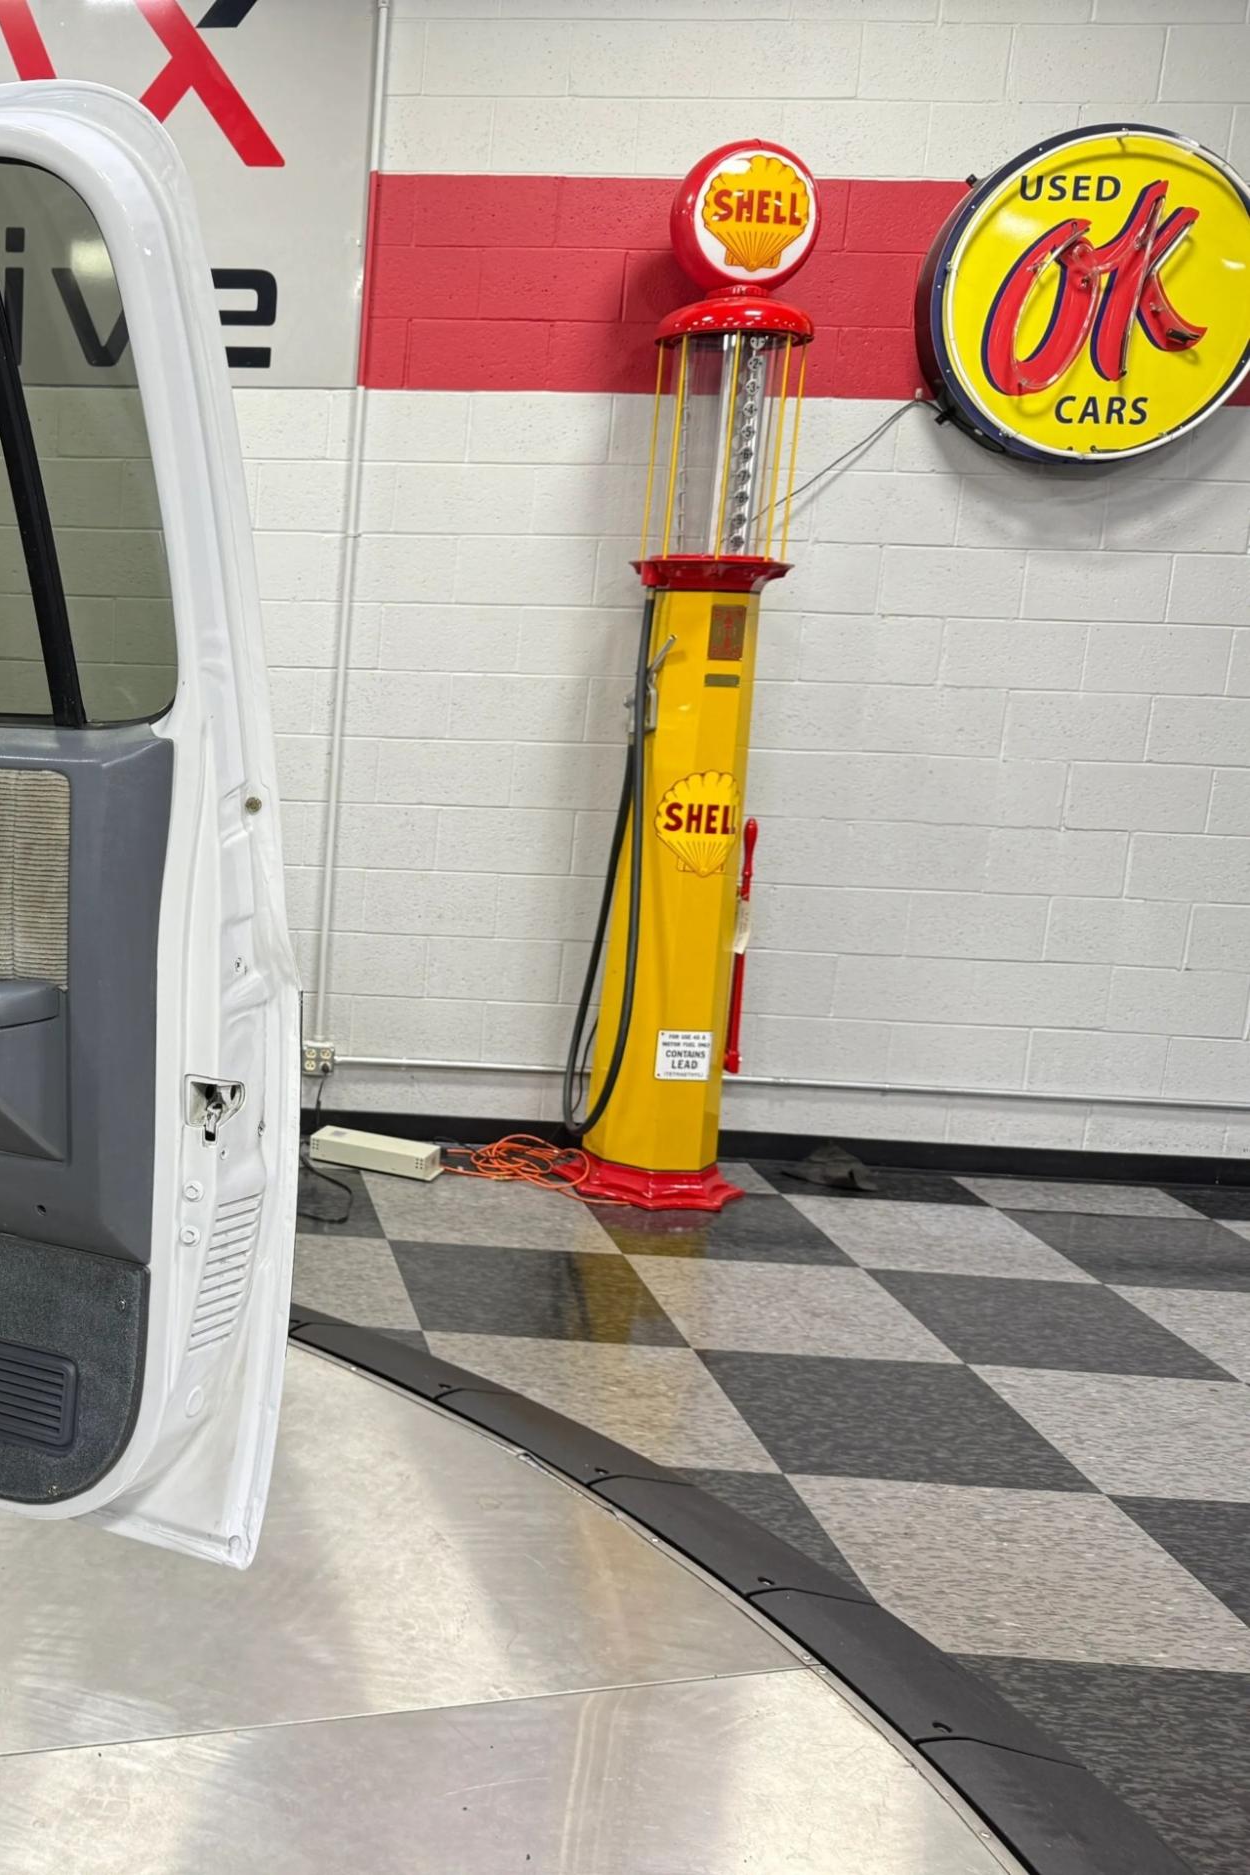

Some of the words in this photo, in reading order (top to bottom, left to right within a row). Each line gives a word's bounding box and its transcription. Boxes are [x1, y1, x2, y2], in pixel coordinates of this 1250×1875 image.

[1019, 175, 1121, 201] USED
[712, 189, 802, 226] SHELL
[1054, 395, 1149, 425] CARS
[666, 1050, 705, 1058] CONTAINS
[671, 1060, 698, 1069] LEAD
